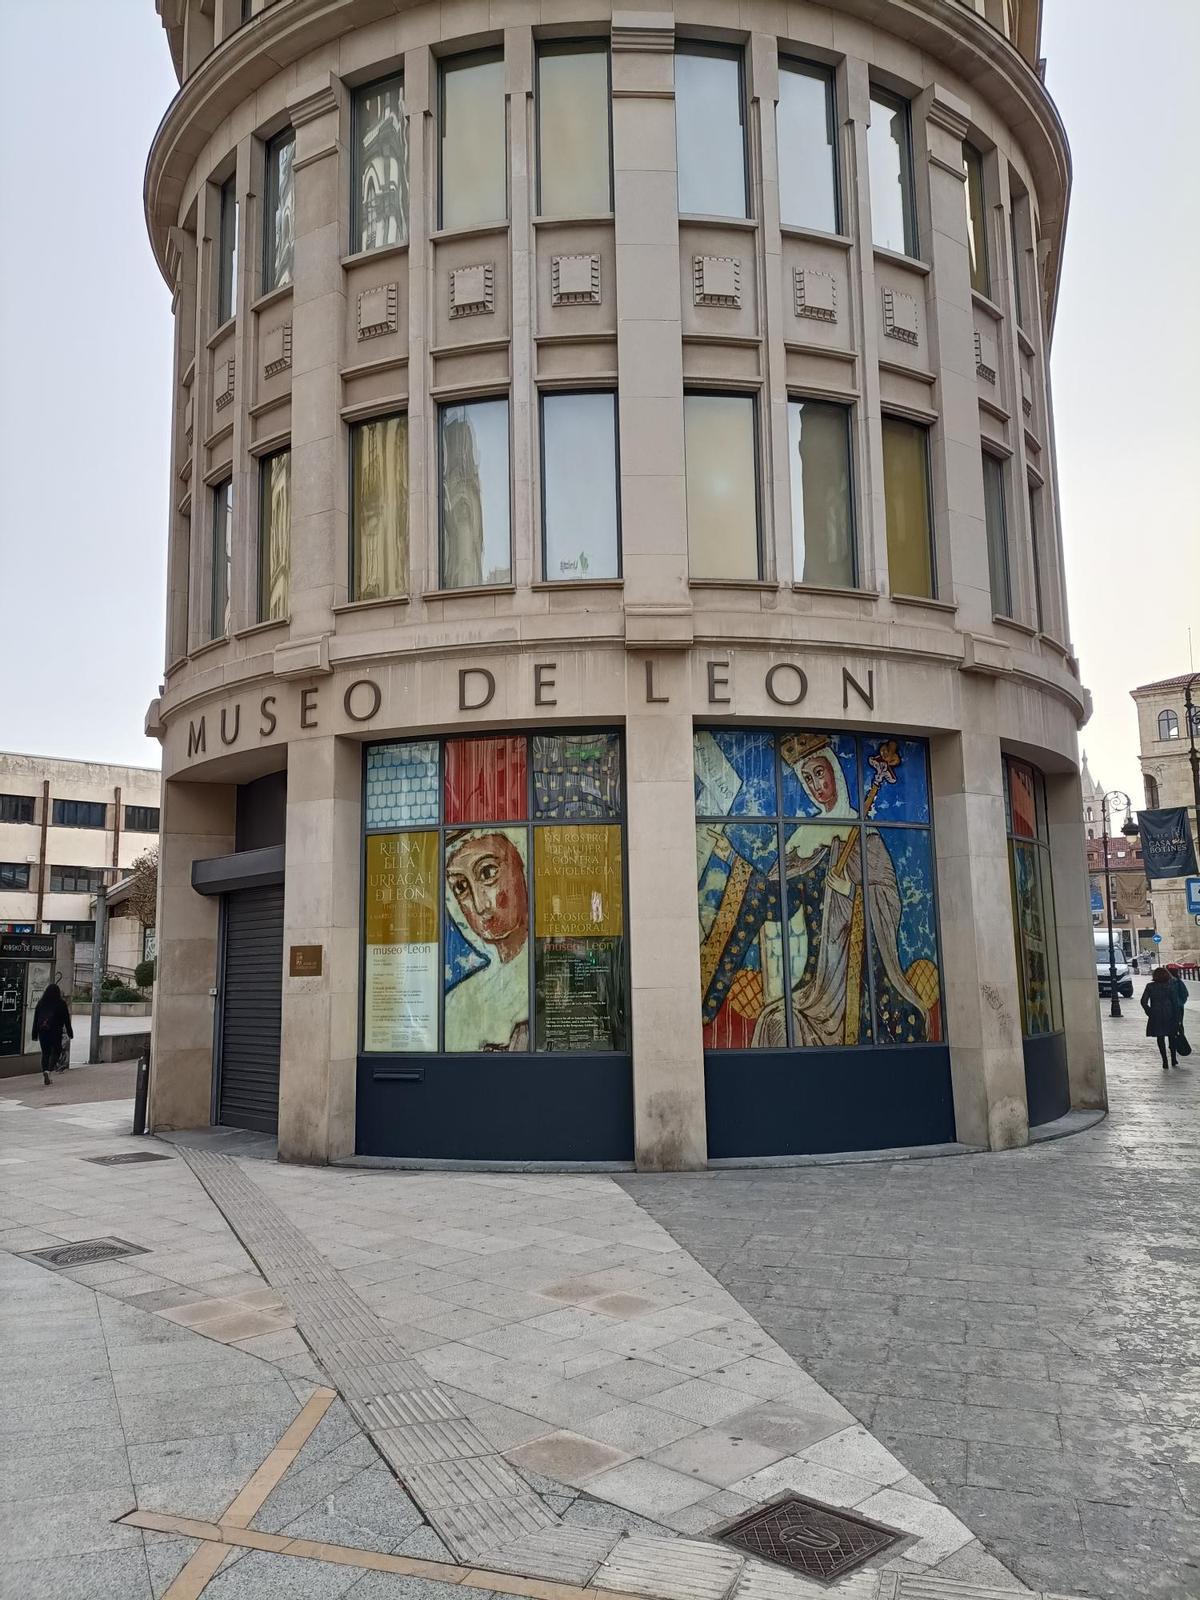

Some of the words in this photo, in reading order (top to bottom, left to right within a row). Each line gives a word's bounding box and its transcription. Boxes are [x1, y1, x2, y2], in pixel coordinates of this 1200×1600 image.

[187, 679, 382, 758] MUSEO
[458, 663, 557, 711] DE
[645, 660, 875, 711] LEON
[564, 832, 608, 843] ROSTRO
[380, 841, 420, 856] REINA
[567, 843, 601, 854] MUJER
[1149, 839, 1171, 848] CASA
[384, 856, 415, 869] ELLA
[552, 854, 599, 865] CONTRA
[370, 872, 424, 888] URRACA
[548, 923, 606, 933] TEMPORAL
[373, 946, 403, 956] museo
